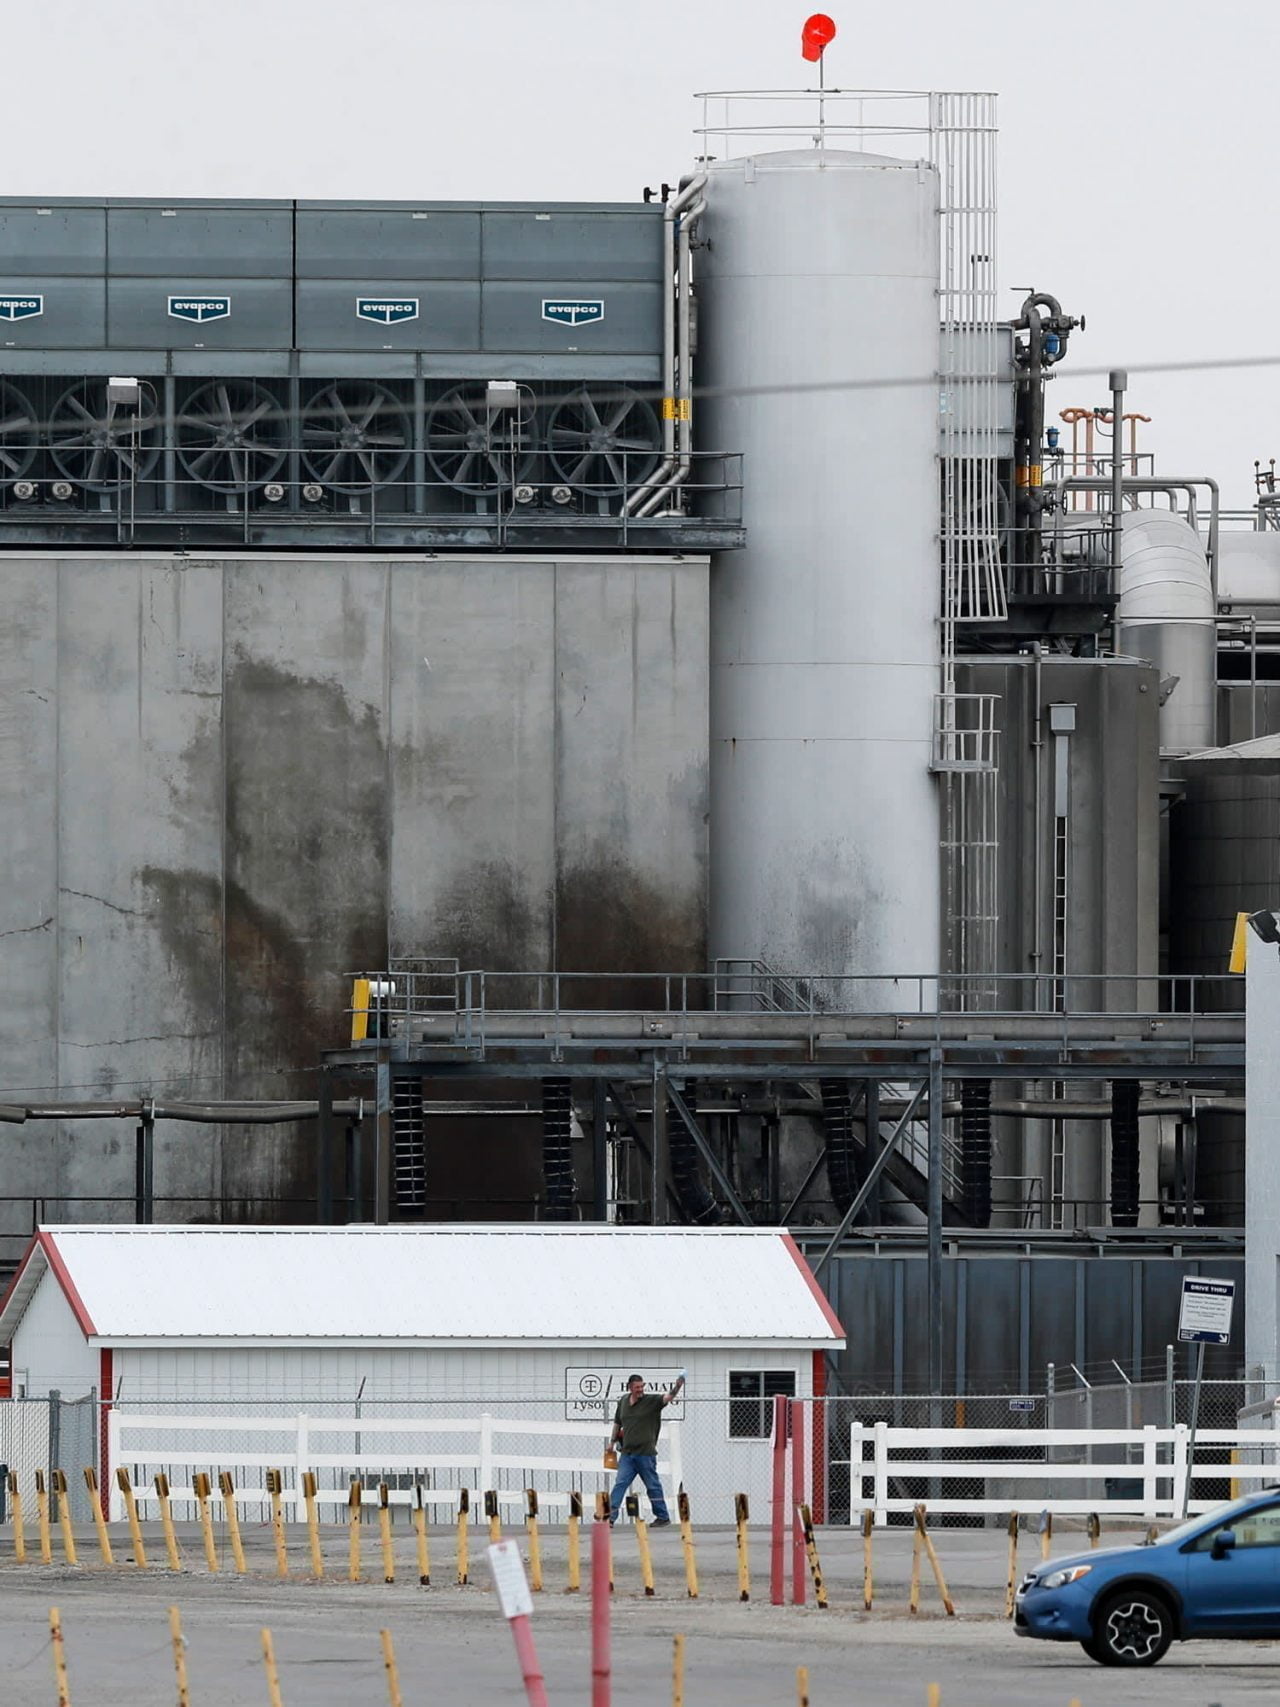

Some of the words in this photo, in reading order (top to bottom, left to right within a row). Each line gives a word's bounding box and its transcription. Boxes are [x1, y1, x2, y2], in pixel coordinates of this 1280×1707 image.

[174, 302, 224, 310] evapco
[363, 304, 412, 312] evapco
[548, 305, 598, 314] evapco
[1191, 1284, 1209, 1292] DRIVE
[621, 1382, 676, 1392] HMAT
